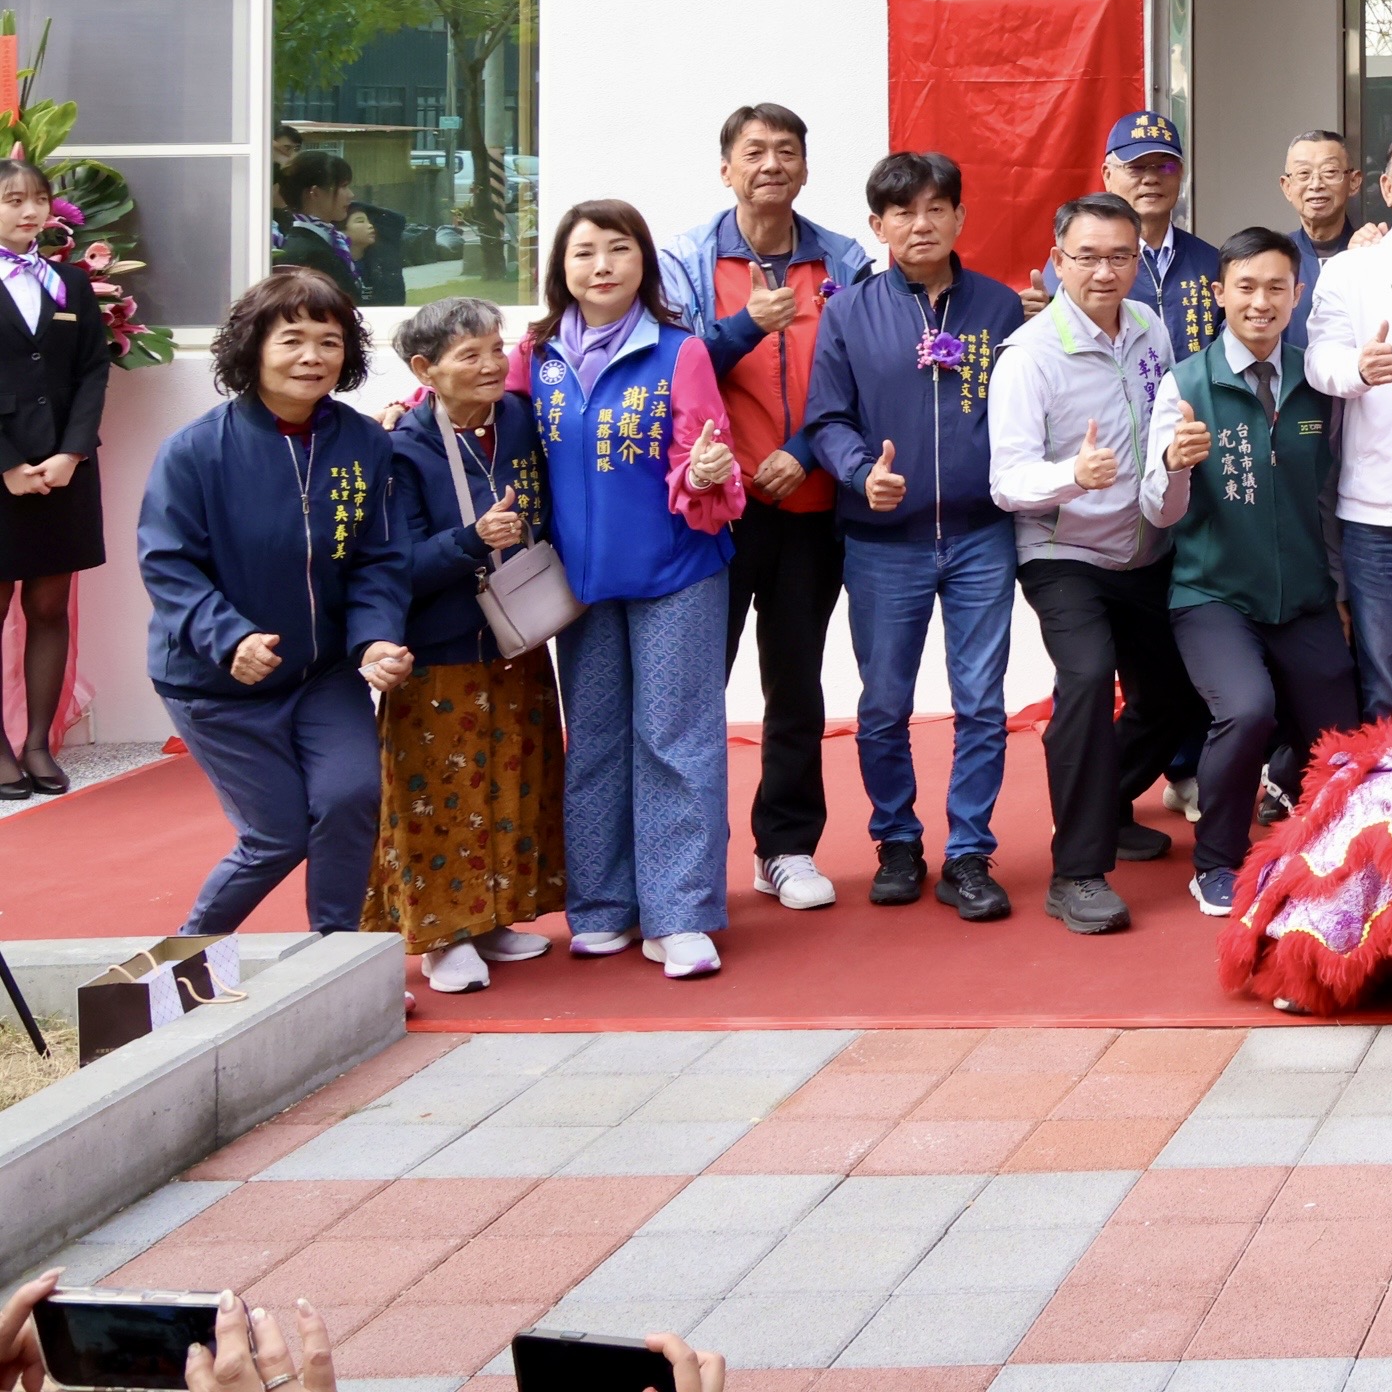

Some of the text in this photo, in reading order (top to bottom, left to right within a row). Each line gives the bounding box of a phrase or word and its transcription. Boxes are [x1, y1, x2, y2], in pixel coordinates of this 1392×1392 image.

[1199, 274, 1214, 336] 臺南市北區
[960, 365, 974, 414] 黃文宗
[978, 329, 990, 399] 臺南市北區
[547, 389, 566, 442] 執行長
[597, 408, 615, 473] 服務團隊
[616, 385, 650, 465] 謝龍介
[647, 379, 671, 460] 立法委員
[352, 460, 367, 538] 臺南市北
[1217, 428, 1241, 501] 沈震東
[1236, 422, 1258, 506] 台南市議員
